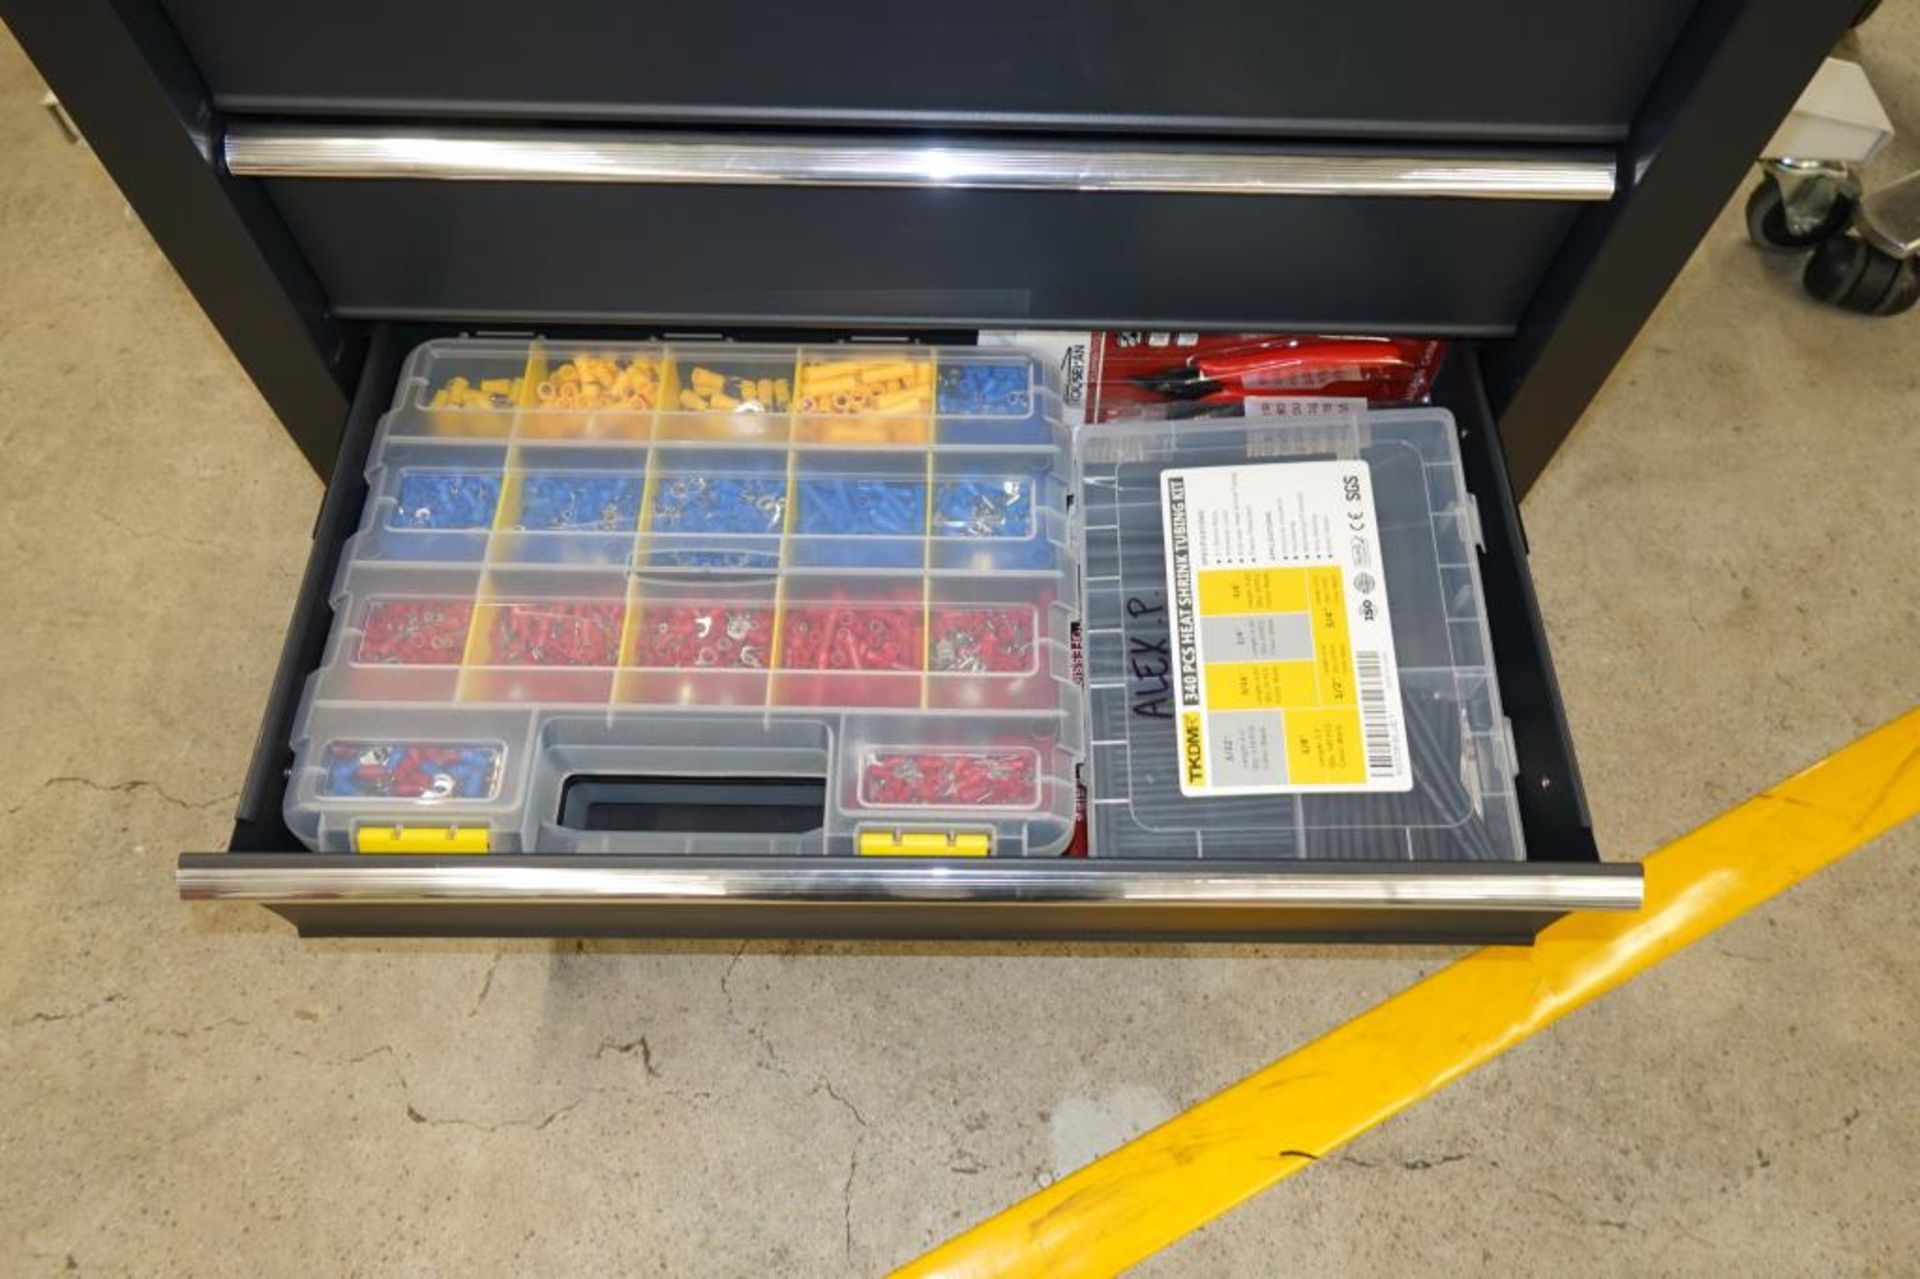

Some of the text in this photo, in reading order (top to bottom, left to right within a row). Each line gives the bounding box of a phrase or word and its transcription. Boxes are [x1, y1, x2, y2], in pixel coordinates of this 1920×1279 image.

[1344, 475, 1361, 502] SGS
[1169, 480, 1199, 702] 340 PCS HEAT SHRINK TUBING KIT
[1362, 599, 1374, 621] ISO
[1130, 637, 1173, 720] ALEX
